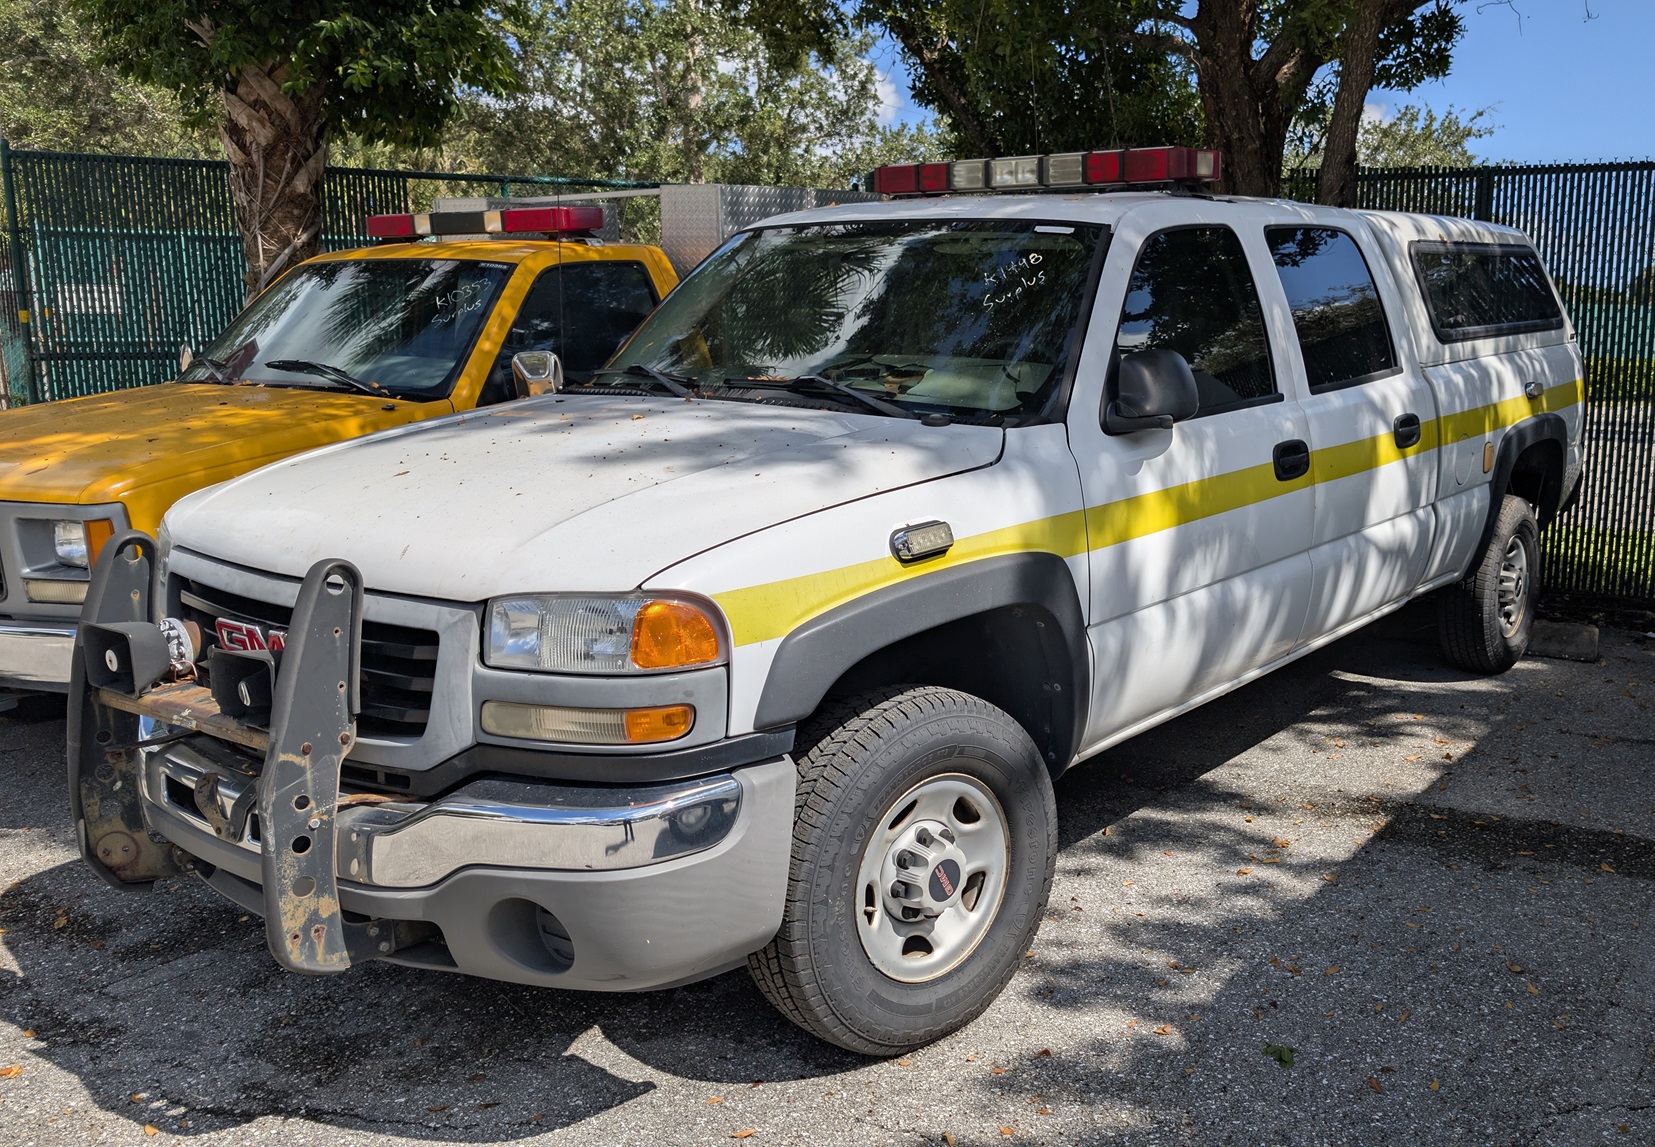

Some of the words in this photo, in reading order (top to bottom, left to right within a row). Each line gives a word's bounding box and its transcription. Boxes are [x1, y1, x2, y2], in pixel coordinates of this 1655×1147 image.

[436, 278, 491, 309] K10353
[431, 299, 481, 328] Surplus
[215, 617, 287, 651] GM
[1012, 778, 1041, 896] Firestone
[935, 865, 954, 896] GMC
